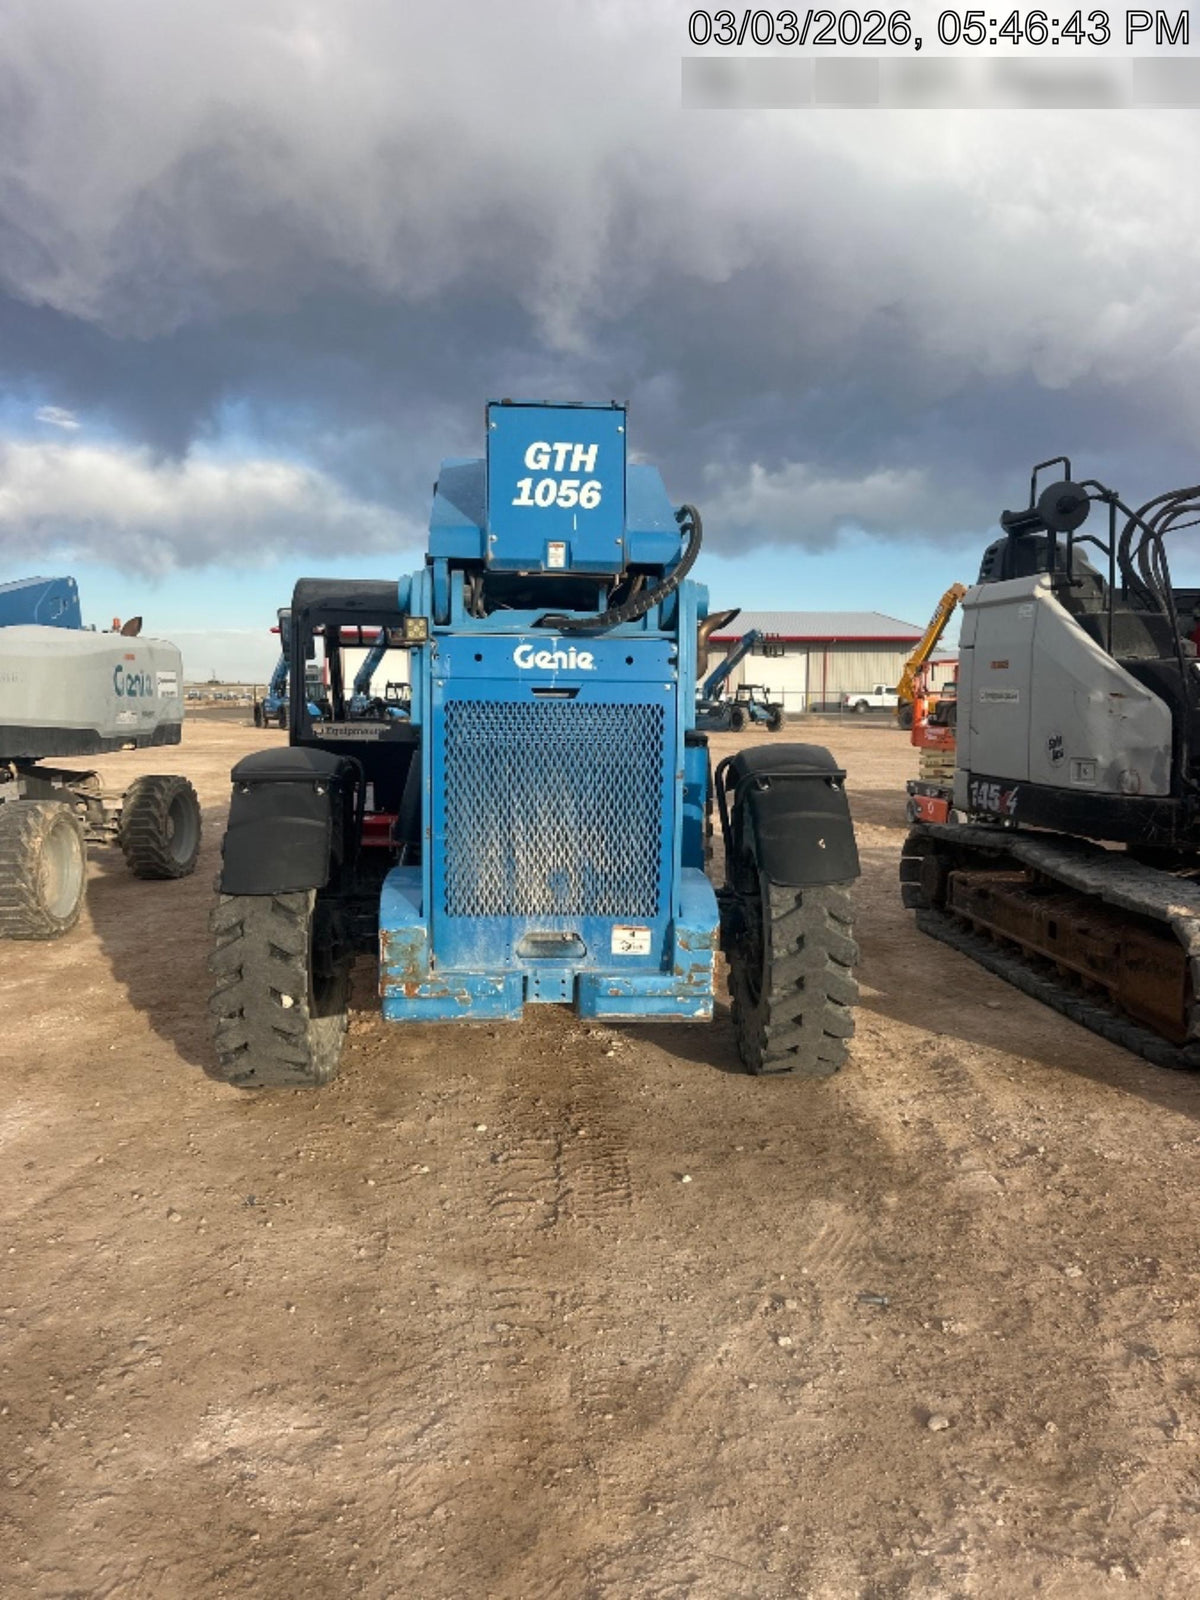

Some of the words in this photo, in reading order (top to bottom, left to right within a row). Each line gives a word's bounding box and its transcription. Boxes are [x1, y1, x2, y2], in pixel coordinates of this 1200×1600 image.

[524, 441, 599, 473] GTH
[511, 477, 602, 509] 1056
[513, 644, 595, 671] Genie
